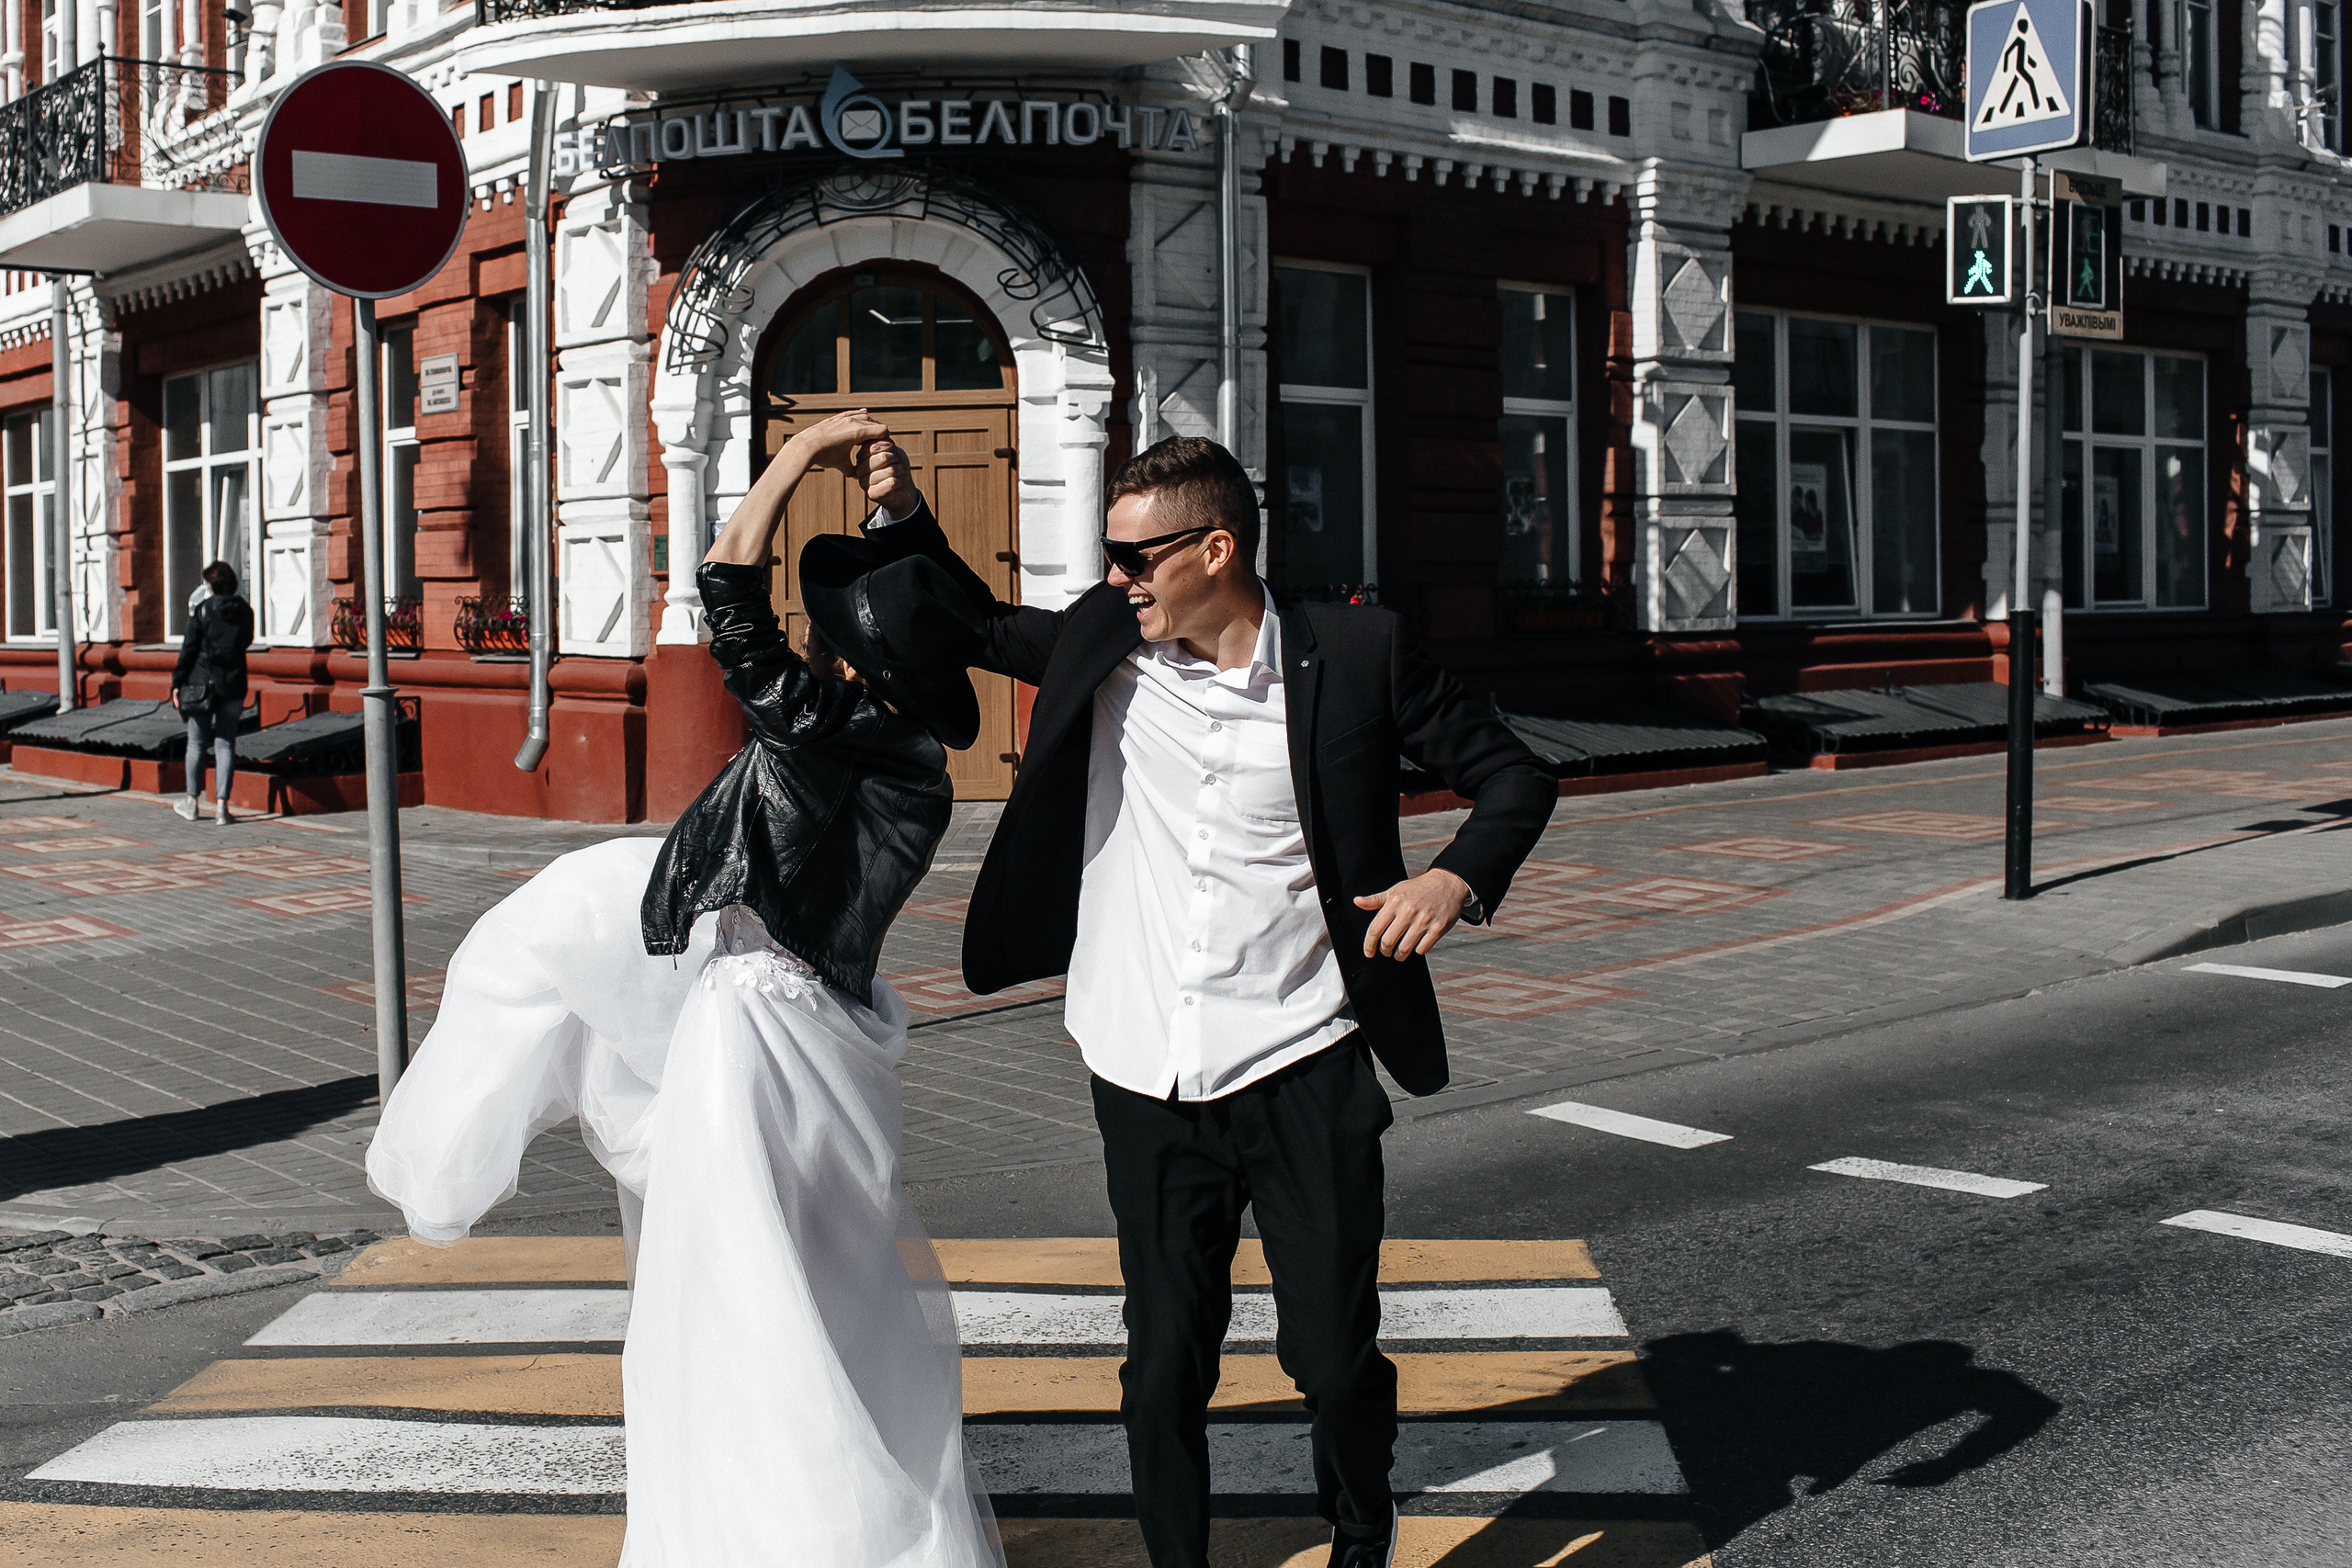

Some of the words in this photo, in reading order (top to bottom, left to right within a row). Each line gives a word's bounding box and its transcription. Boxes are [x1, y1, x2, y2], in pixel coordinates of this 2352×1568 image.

[554, 107, 821, 175] БЕЛПОШТА
[899, 99, 1199, 152] БЕЛПОЧТА
[2059, 313, 2116, 331] УВАЖЛІВЫМІ
